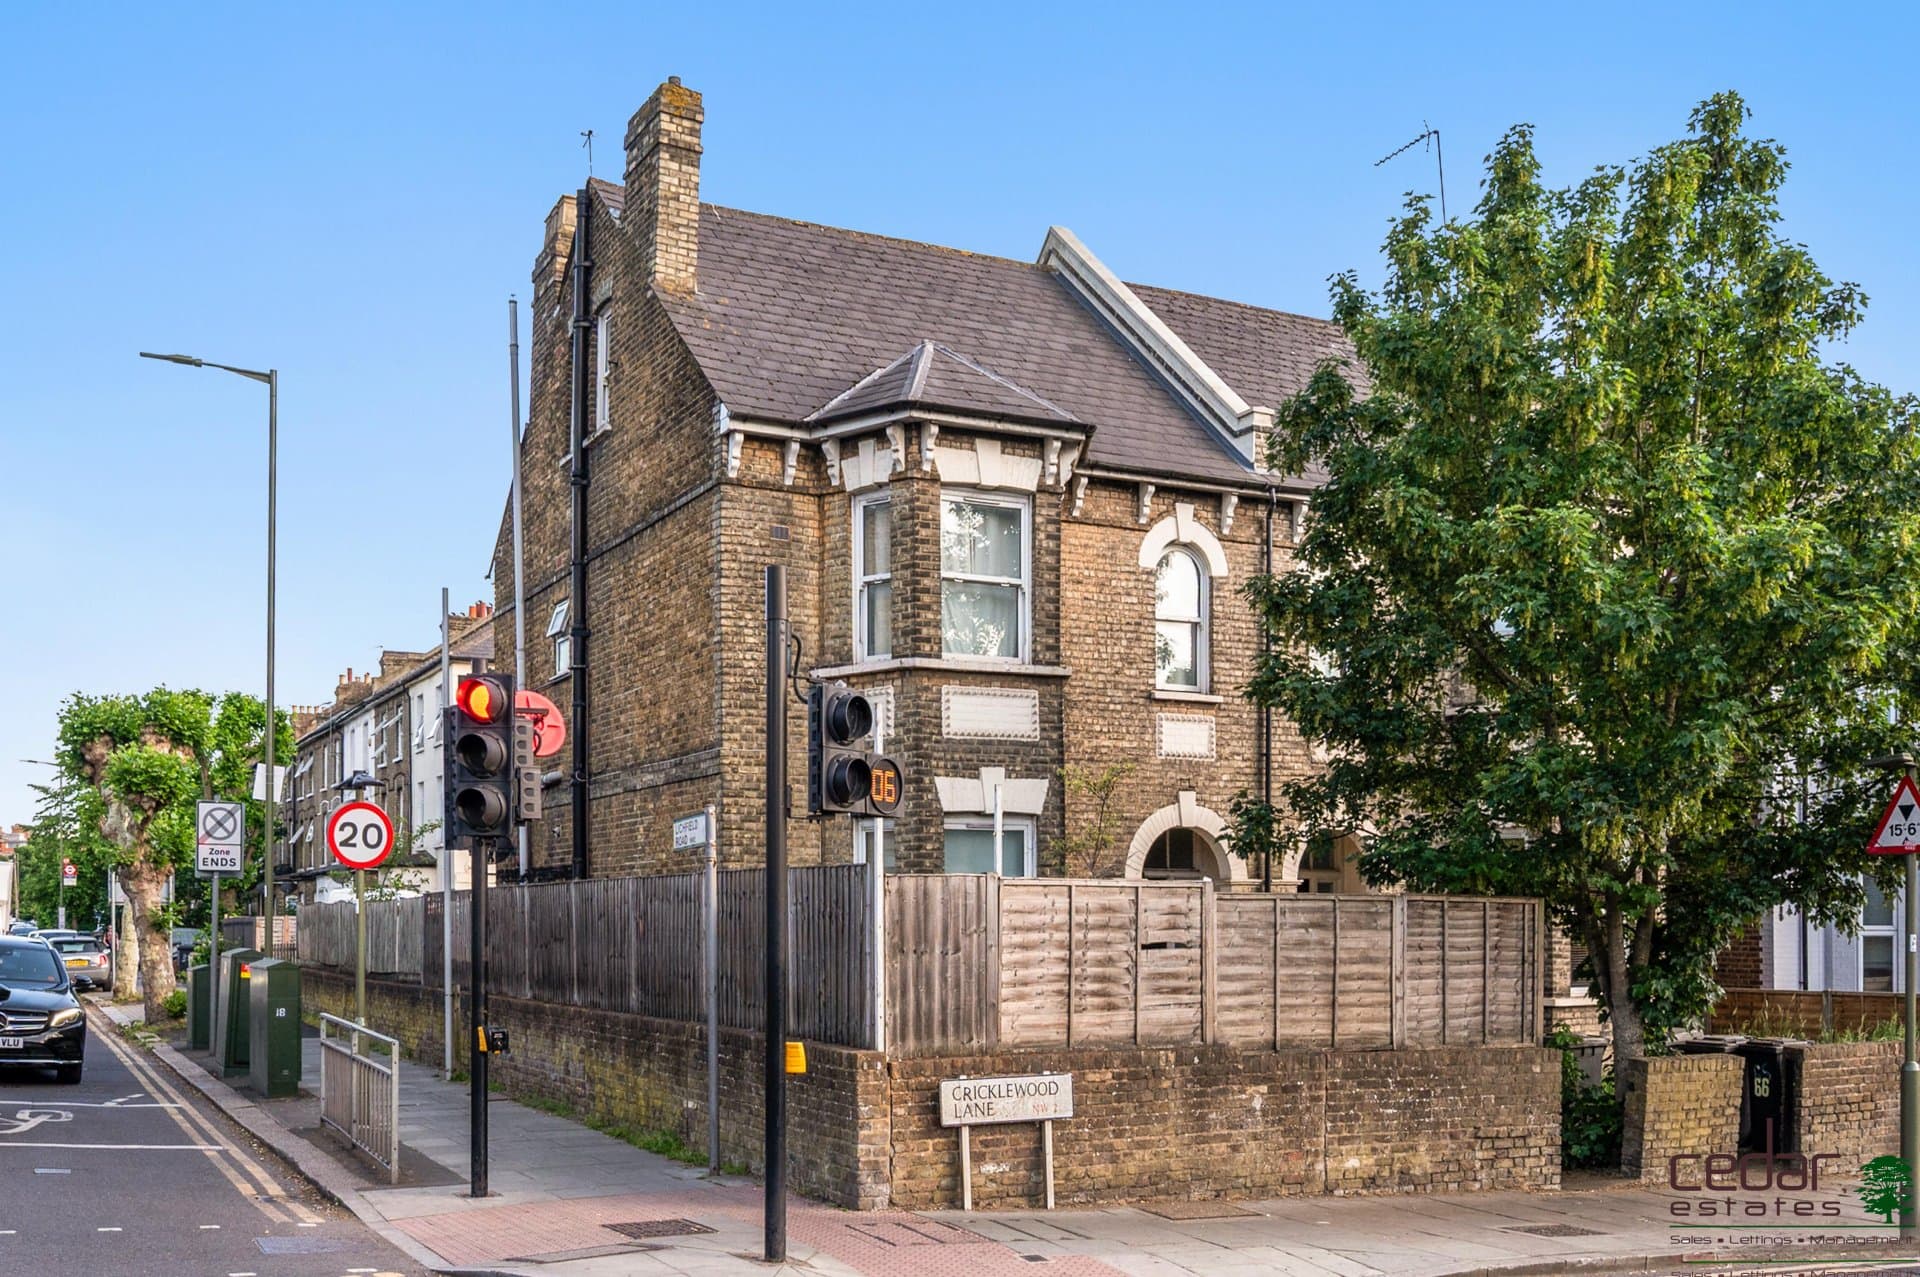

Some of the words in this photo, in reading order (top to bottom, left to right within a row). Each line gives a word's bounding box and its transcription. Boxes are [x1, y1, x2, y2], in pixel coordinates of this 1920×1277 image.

[871, 769, 896, 803] 06
[338, 821, 383, 850] 20
[208, 847, 231, 856] Zone
[202, 857, 237, 867] ENDS
[951, 1081, 1060, 1102] CRICKLEWOOD
[1754, 1077, 1770, 1097] 66
[954, 1101, 995, 1119] LANE
